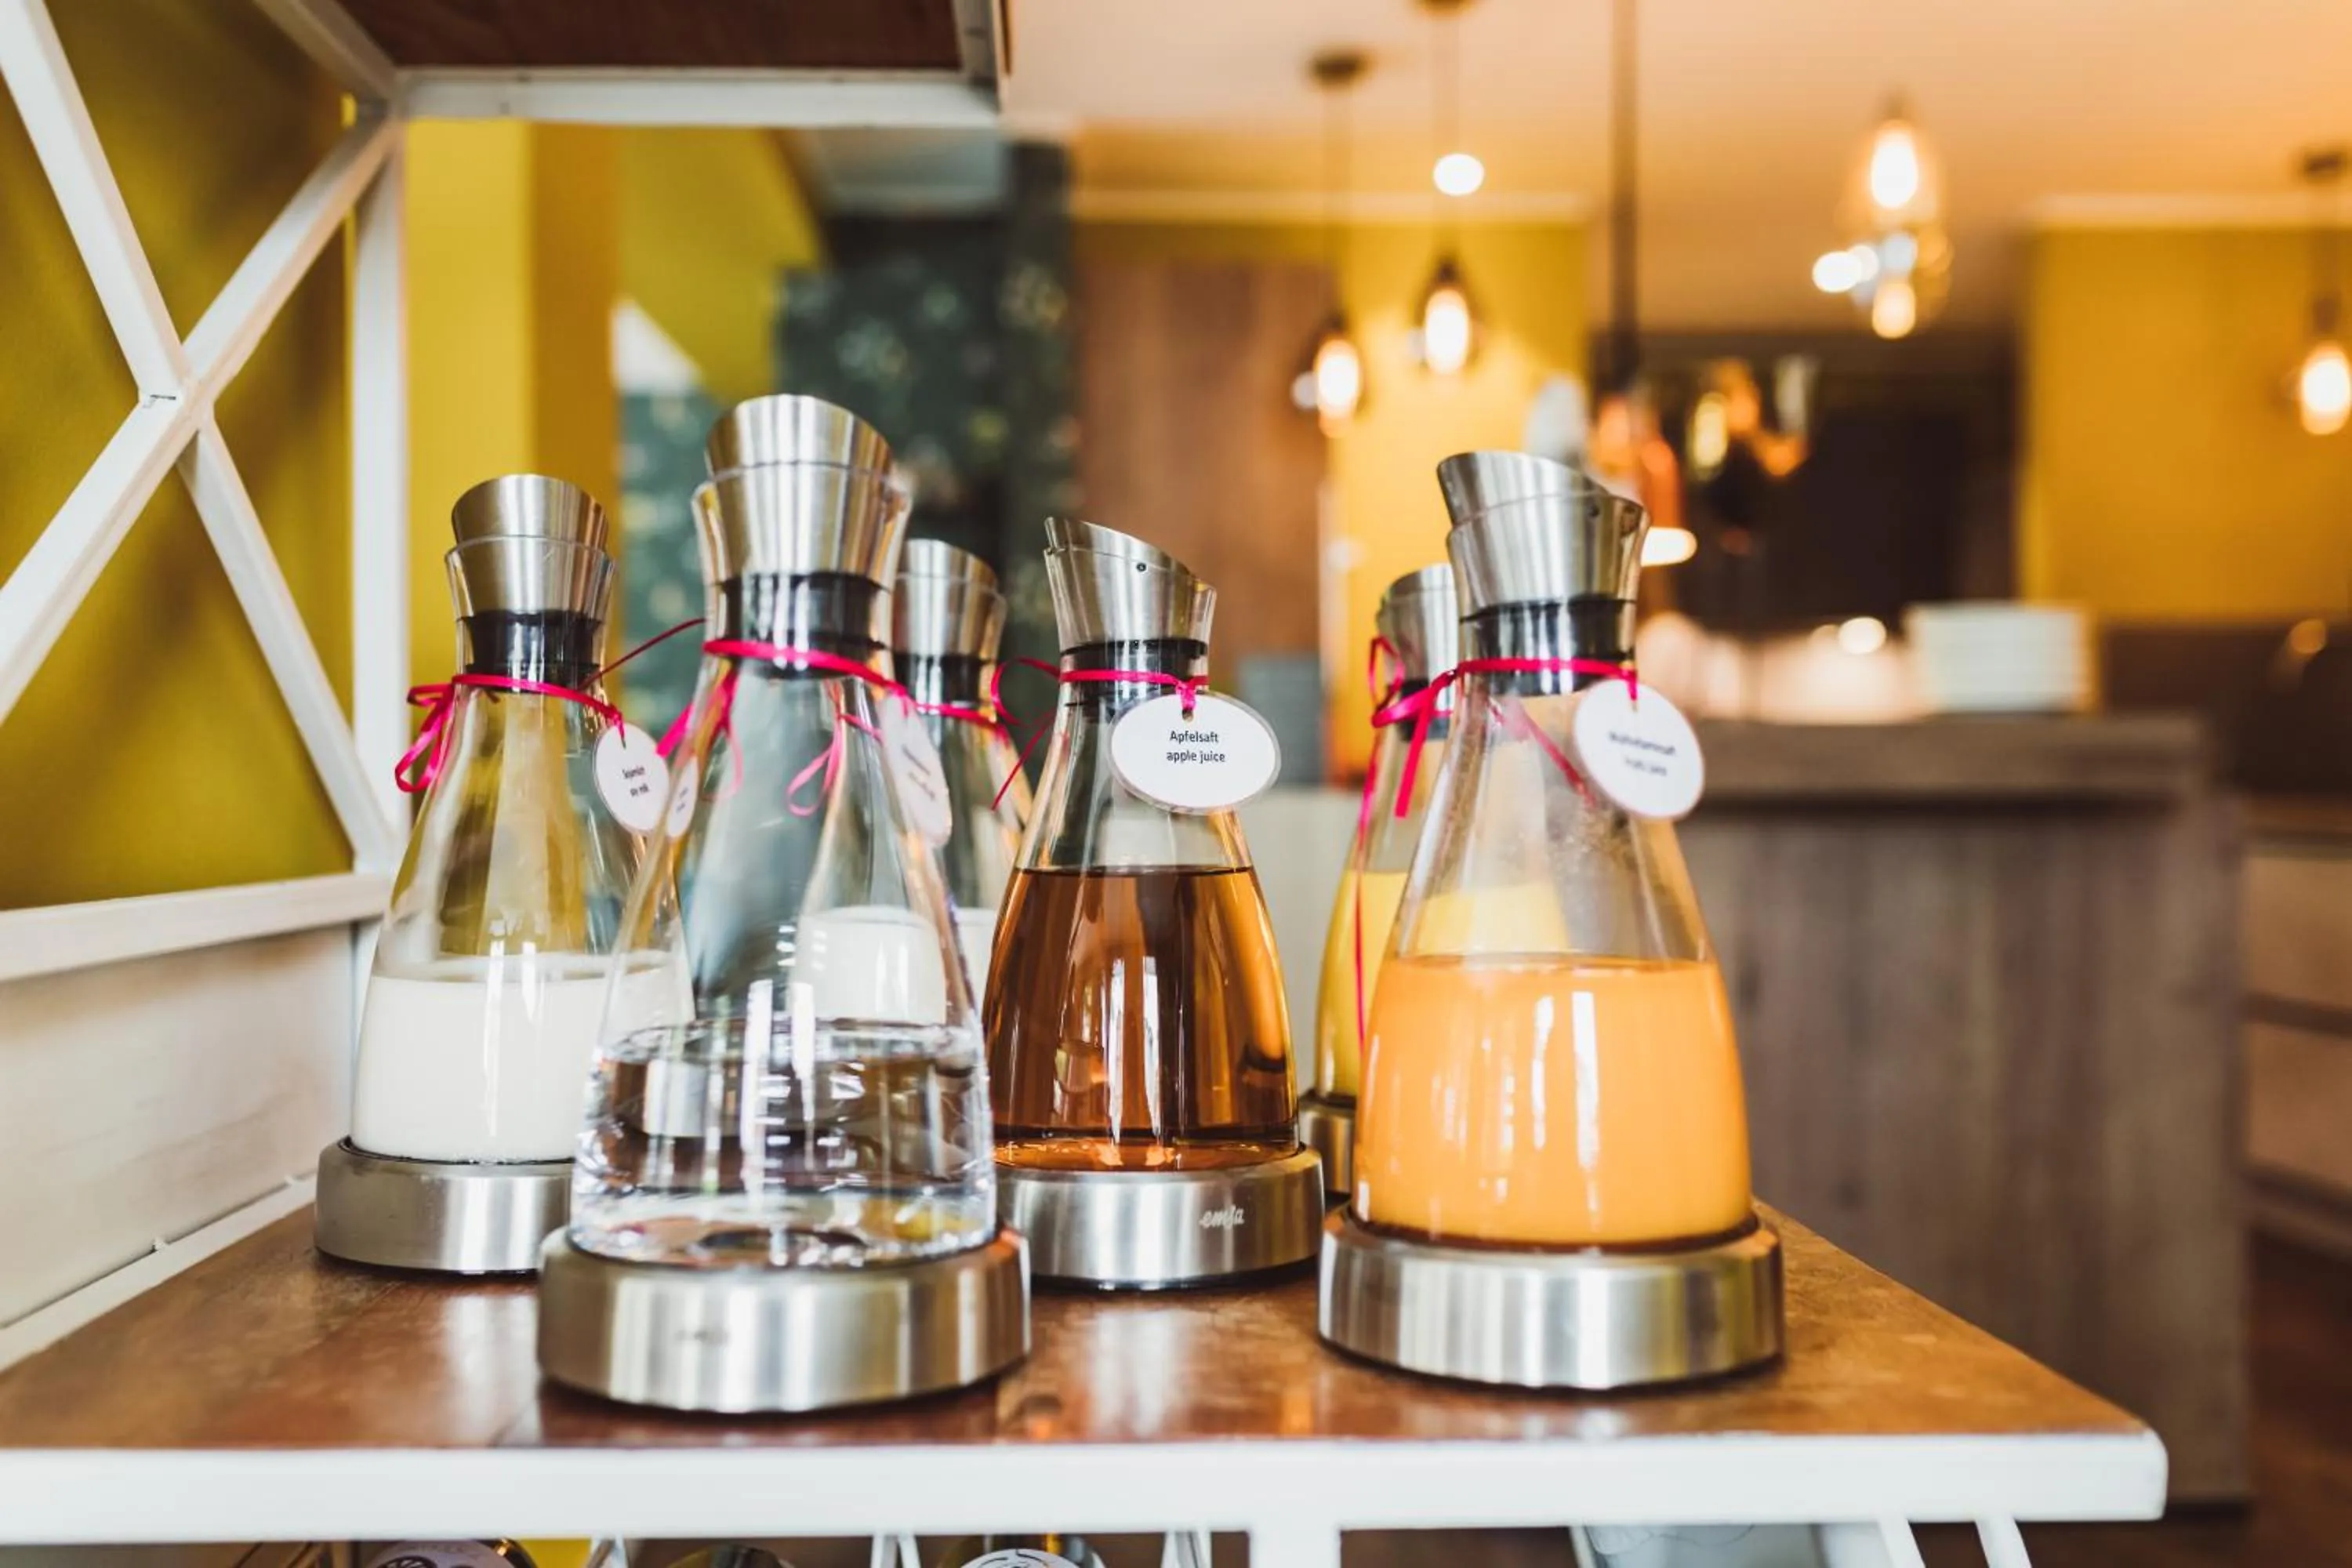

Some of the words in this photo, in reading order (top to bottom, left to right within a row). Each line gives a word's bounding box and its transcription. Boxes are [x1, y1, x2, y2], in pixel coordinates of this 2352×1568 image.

[1170, 730, 1218, 744] Apfelsaft
[1167, 750, 1196, 763] apple
[1200, 750, 1225, 764] juice
